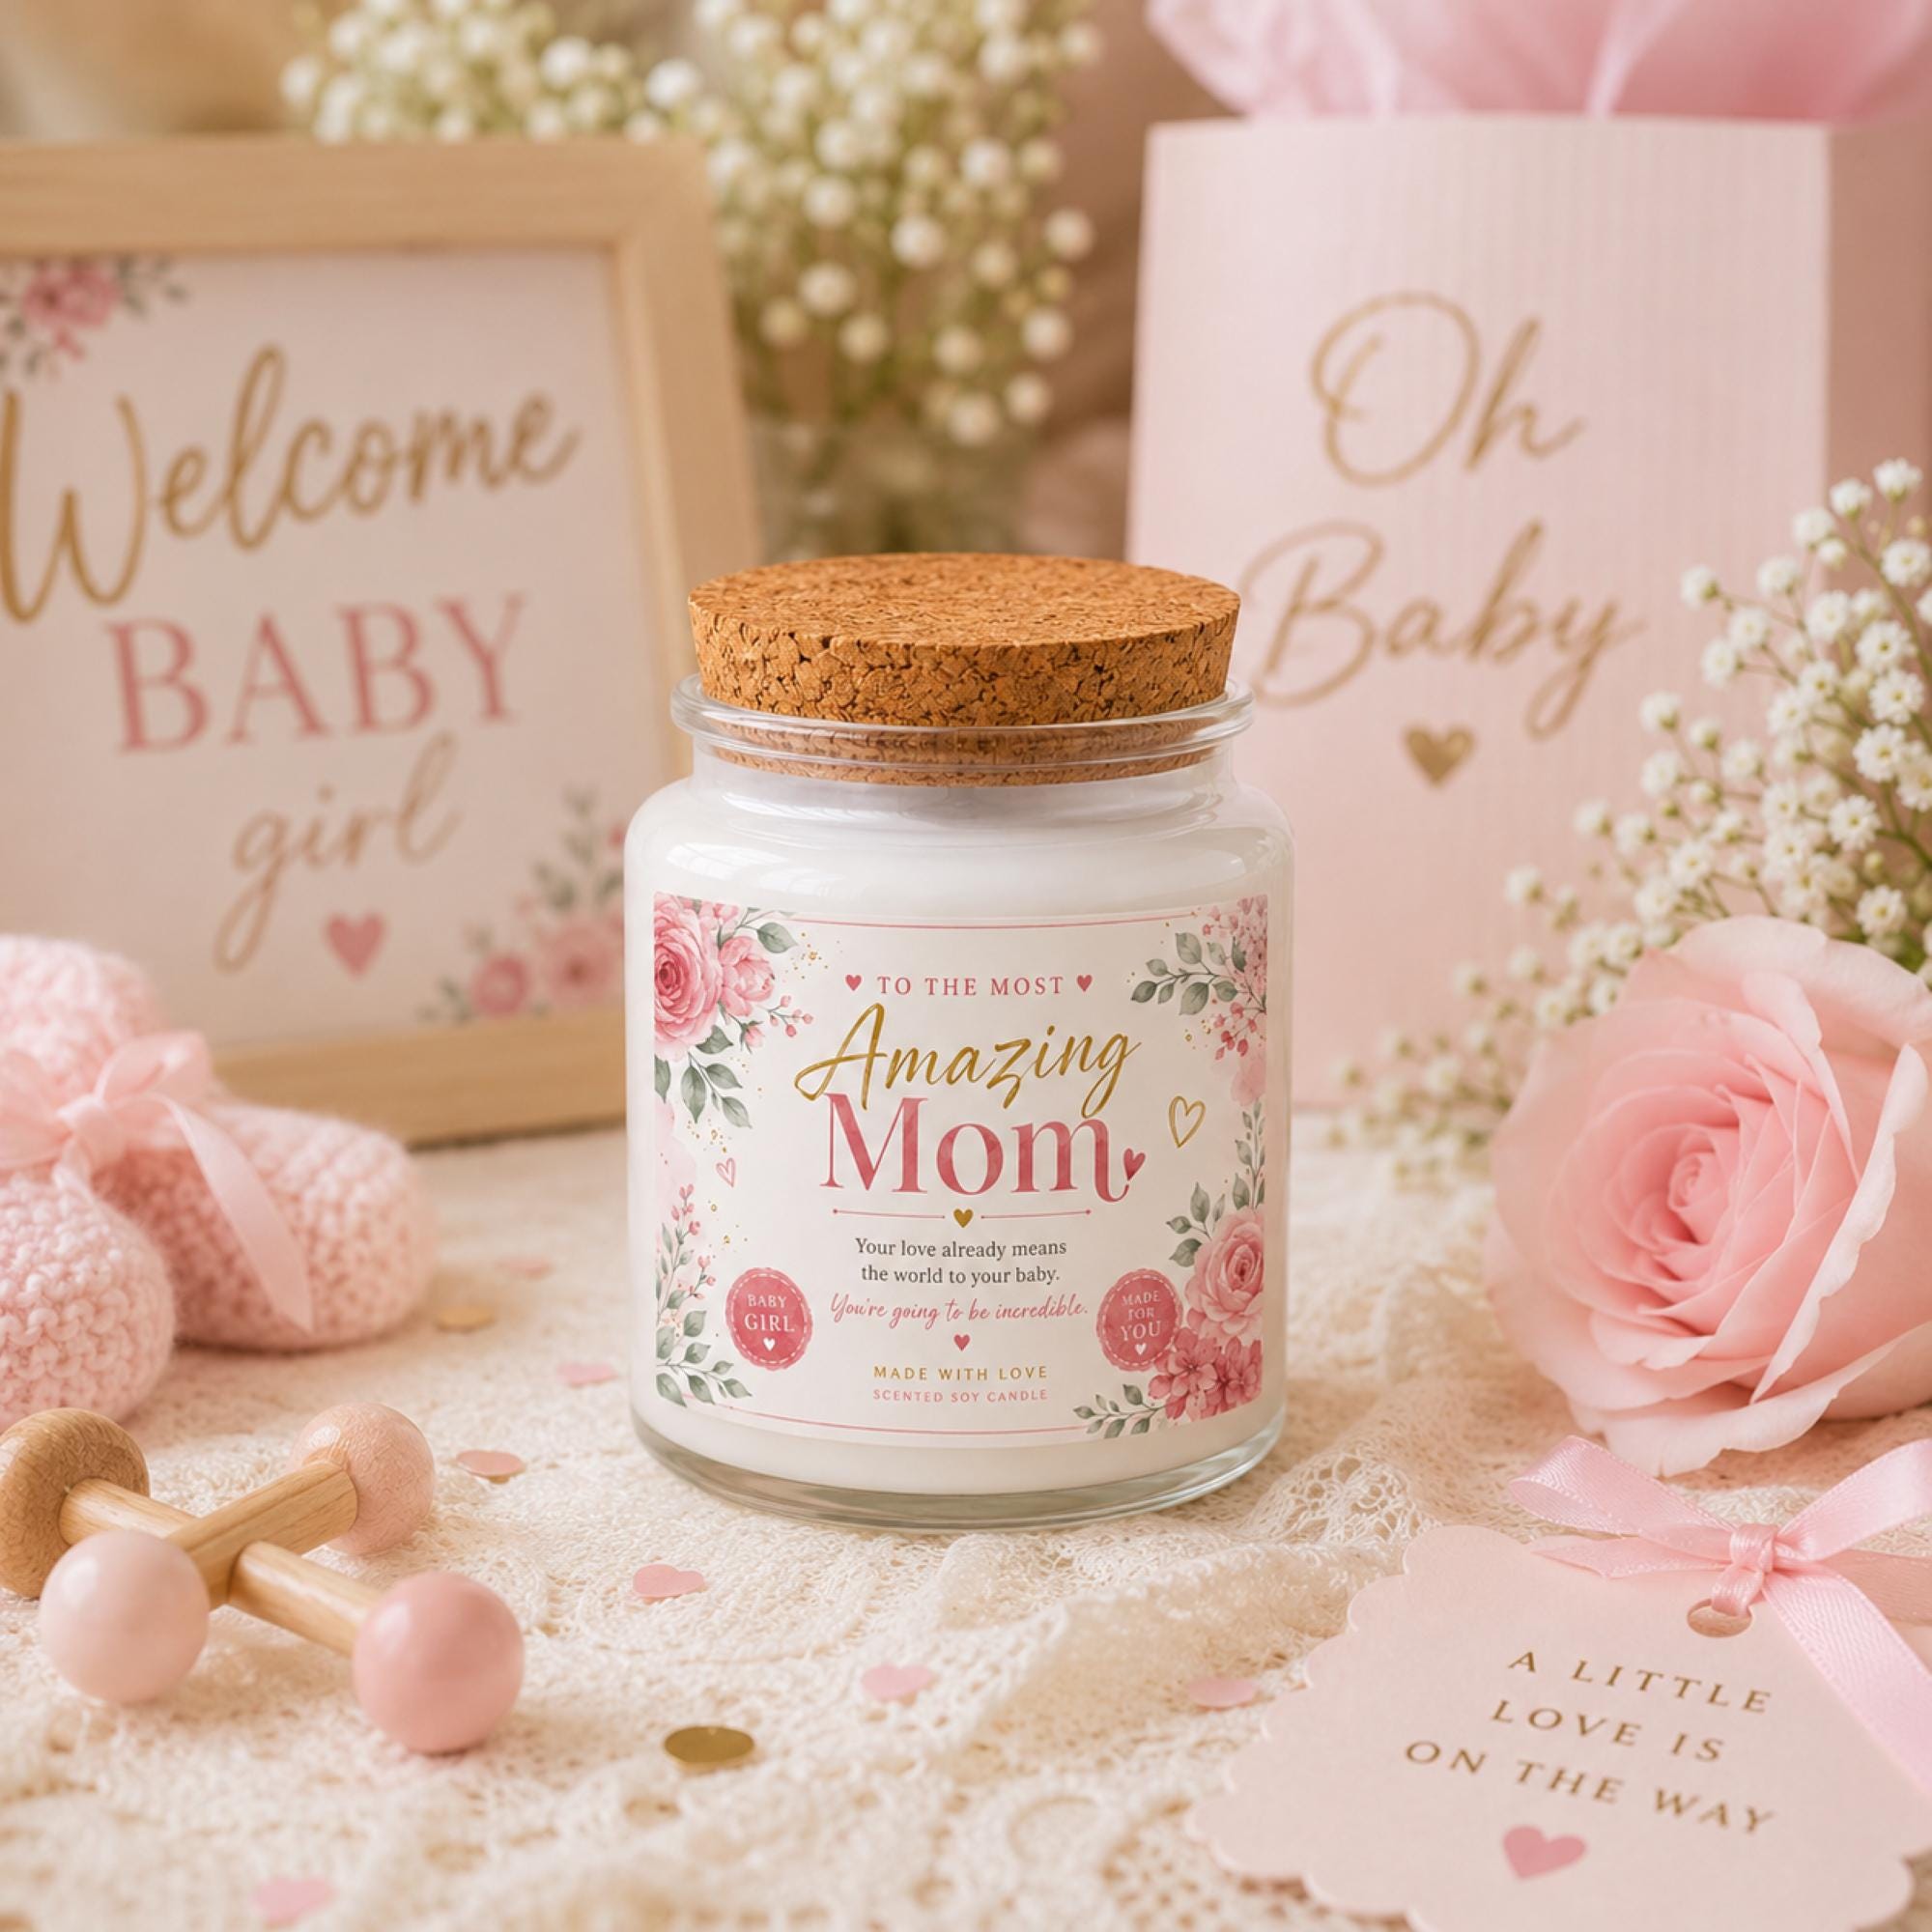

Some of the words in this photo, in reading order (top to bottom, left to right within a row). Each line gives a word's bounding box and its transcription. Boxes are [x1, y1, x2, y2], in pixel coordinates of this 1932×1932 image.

[1307, 290, 1590, 490] Oh
[0, 341, 582, 626] Welcome
[1239, 517, 1647, 743] Baby
[101, 591, 532, 756] BABY
[213, 729, 464, 977] girl
[877, 976, 912, 996] TO
[924, 977, 977, 997] THE
[990, 976, 1064, 996] MOST
[794, 1002, 1142, 1119] Amazing
[819, 1092, 1130, 1203] Mom
[855, 1237, 896, 1256] Your
[900, 1239, 937, 1258] love
[942, 1240, 1007, 1261] already
[1011, 1240, 1067, 1257] means
[861, 1264, 889, 1282] the
[894, 1266, 944, 1284] world
[949, 1269, 966, 1284] to
[970, 1271, 1012, 1288] your
[1015, 1265, 1061, 1286] baby.
[747, 1293, 787, 1308] BABY
[830, 1293, 888, 1322] You're
[889, 1302, 940, 1329] going
[945, 1298, 964, 1321] to
[968, 1297, 991, 1321] be
[995, 1293, 1089, 1320] incredible.
[1122, 1290, 1161, 1306] MADE
[1127, 1307, 1155, 1321] FOR
[744, 1313, 796, 1332] GIRL
[1121, 1320, 1161, 1342] YOU
[873, 1365, 928, 1380] MADE
[938, 1367, 988, 1381] WITH
[999, 1365, 1048, 1380] LOVE
[872, 1388, 944, 1403] SCENTED
[951, 1391, 980, 1403] SOY
[986, 1388, 1048, 1402] CANDLE
[1508, 1650, 1537, 1674] A
[1571, 1660, 1772, 1714] LITTLE
[1491, 1699, 1642, 1747] LOVE
[1671, 1732, 1726, 1763] IS
[1405, 1741, 1488, 1775] ON
[1515, 1759, 1626, 1804] THE
[1653, 1787, 1776, 1834] WAY
